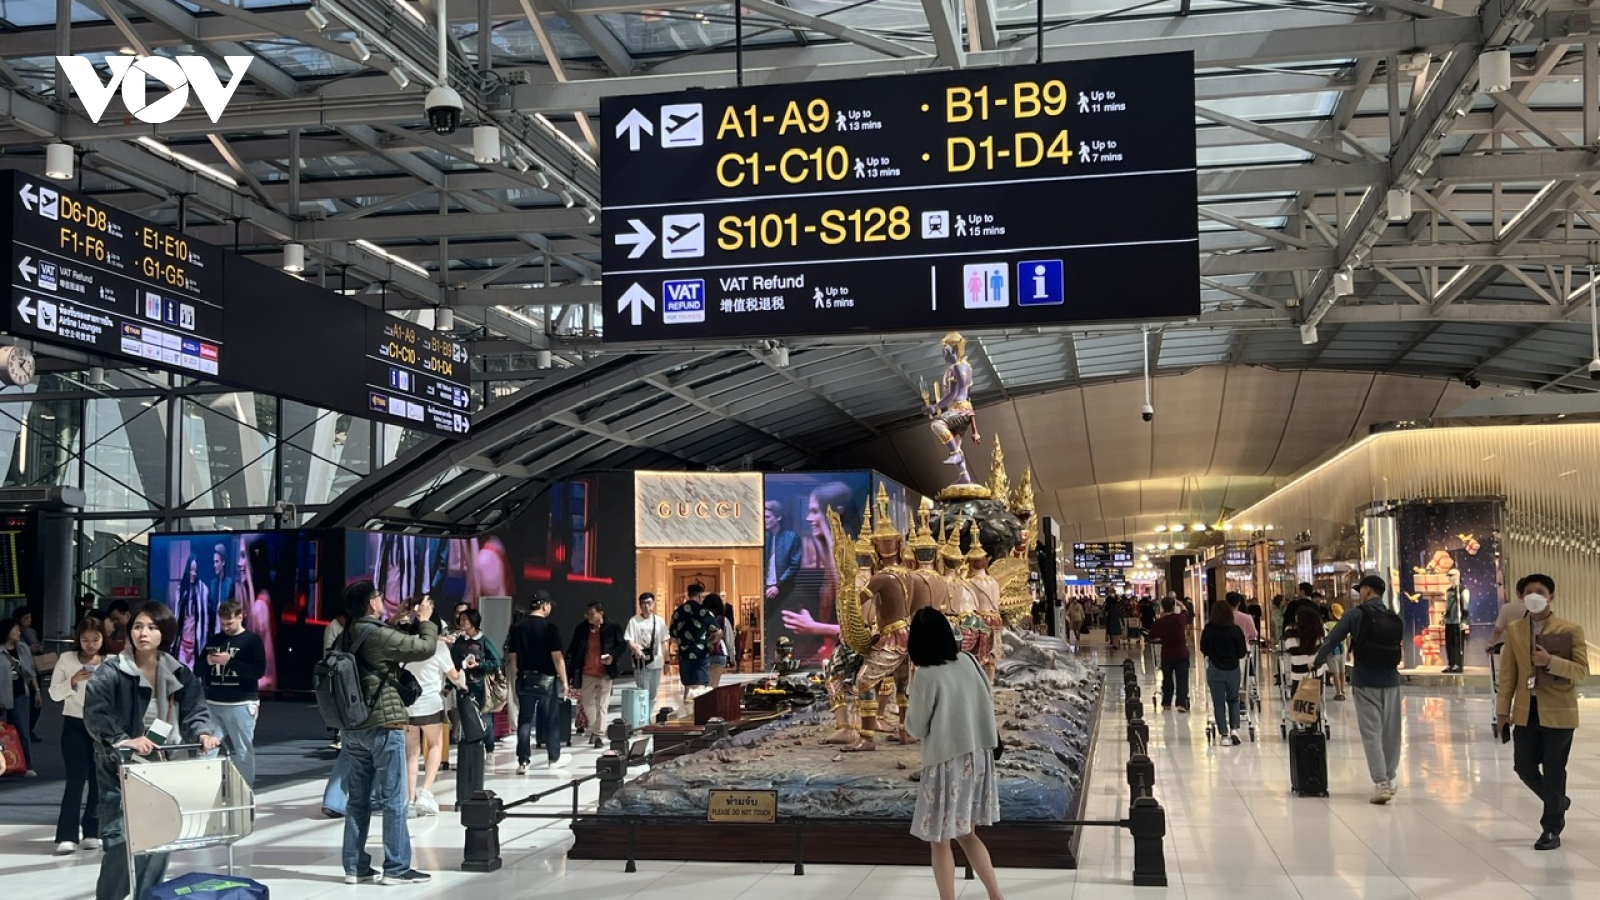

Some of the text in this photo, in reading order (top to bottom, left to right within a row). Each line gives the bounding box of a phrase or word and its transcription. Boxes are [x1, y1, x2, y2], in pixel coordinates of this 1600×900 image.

[946, 80, 1067, 123] B1-B9
[1091, 91, 1115, 102] Up to
[1092, 102, 1126, 112] 11 mins
[716, 99, 830, 139] A1-A9
[849, 110, 871, 120] Up to
[849, 121, 882, 130] 13 mins
[947, 130, 1073, 172] D1-D4
[1092, 140, 1116, 151] Up to
[867, 157, 890, 168] Up to
[1092, 153, 1123, 162] 7 mins
[716, 146, 849, 187] C1-C10
[867, 167, 900, 177] 13 mins
[61, 195, 107, 232] D6-D8
[968, 215, 994, 225] Up to
[717, 206, 911, 250] S101-S128
[969, 226, 1005, 236] 15 mins
[60, 228, 105, 261] F1-F6
[143, 227, 188, 261] E1-E10
[41, 264, 56, 276] VAT
[59, 266, 71, 277] VAT
[143, 257, 185, 287] G1-G5
[720, 274, 805, 292] VAT Refund
[667, 283, 701, 300] VAT
[825, 287, 849, 297] Up to
[668, 301, 701, 311] REFUND
[825, 298, 855, 308] 5 mins
[393, 323, 416, 344] A1-A9
[389, 342, 416, 364] C1-C10
[431, 357, 452, 376] D1-D4
[658, 500, 741, 518] GUCCI
